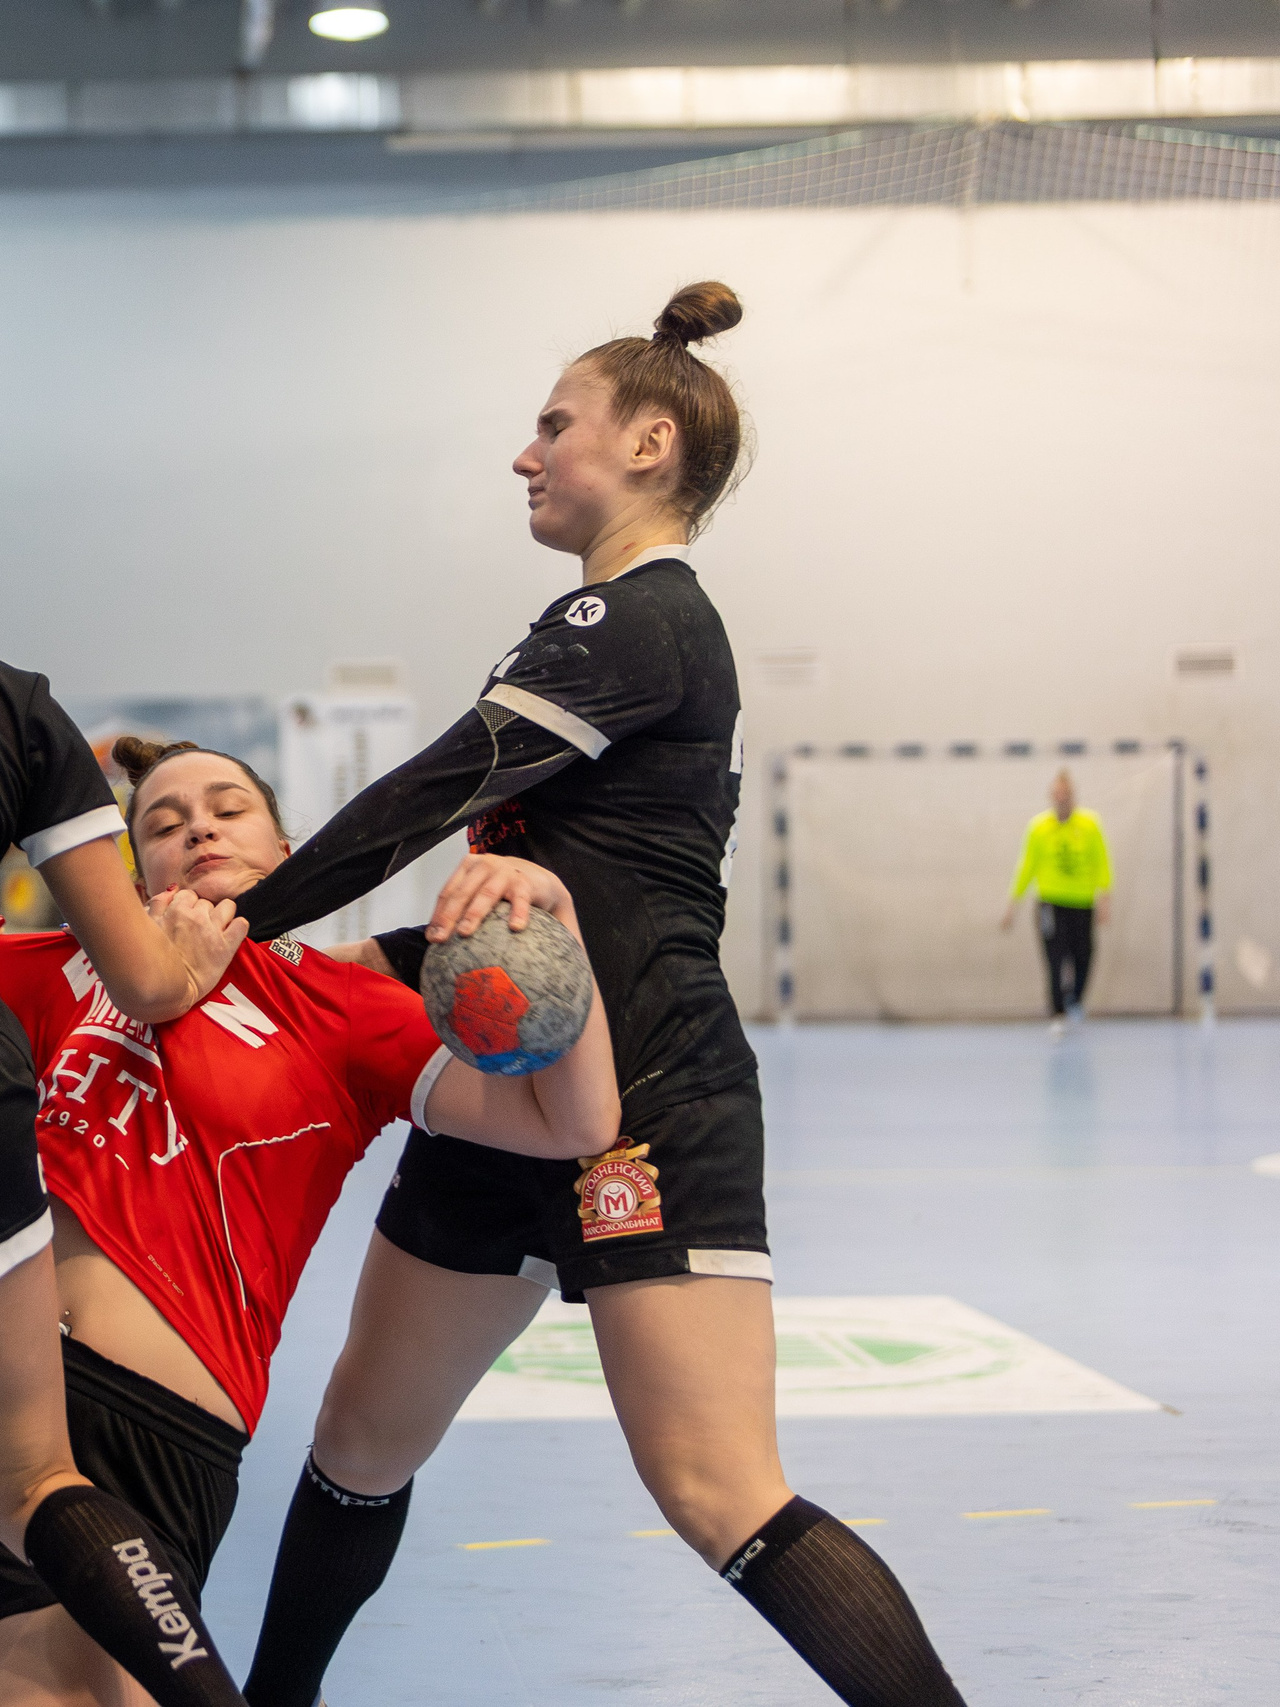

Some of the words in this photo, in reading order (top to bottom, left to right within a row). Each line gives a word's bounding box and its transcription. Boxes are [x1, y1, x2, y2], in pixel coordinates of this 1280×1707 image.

[271, 942, 301, 965] BELAZ
[585, 1163, 653, 1203] ГРОДНЕНСКИЙ
[584, 1217, 659, 1236] МЯСОКОМБИНАТ
[111, 1536, 209, 1671] Kempa
